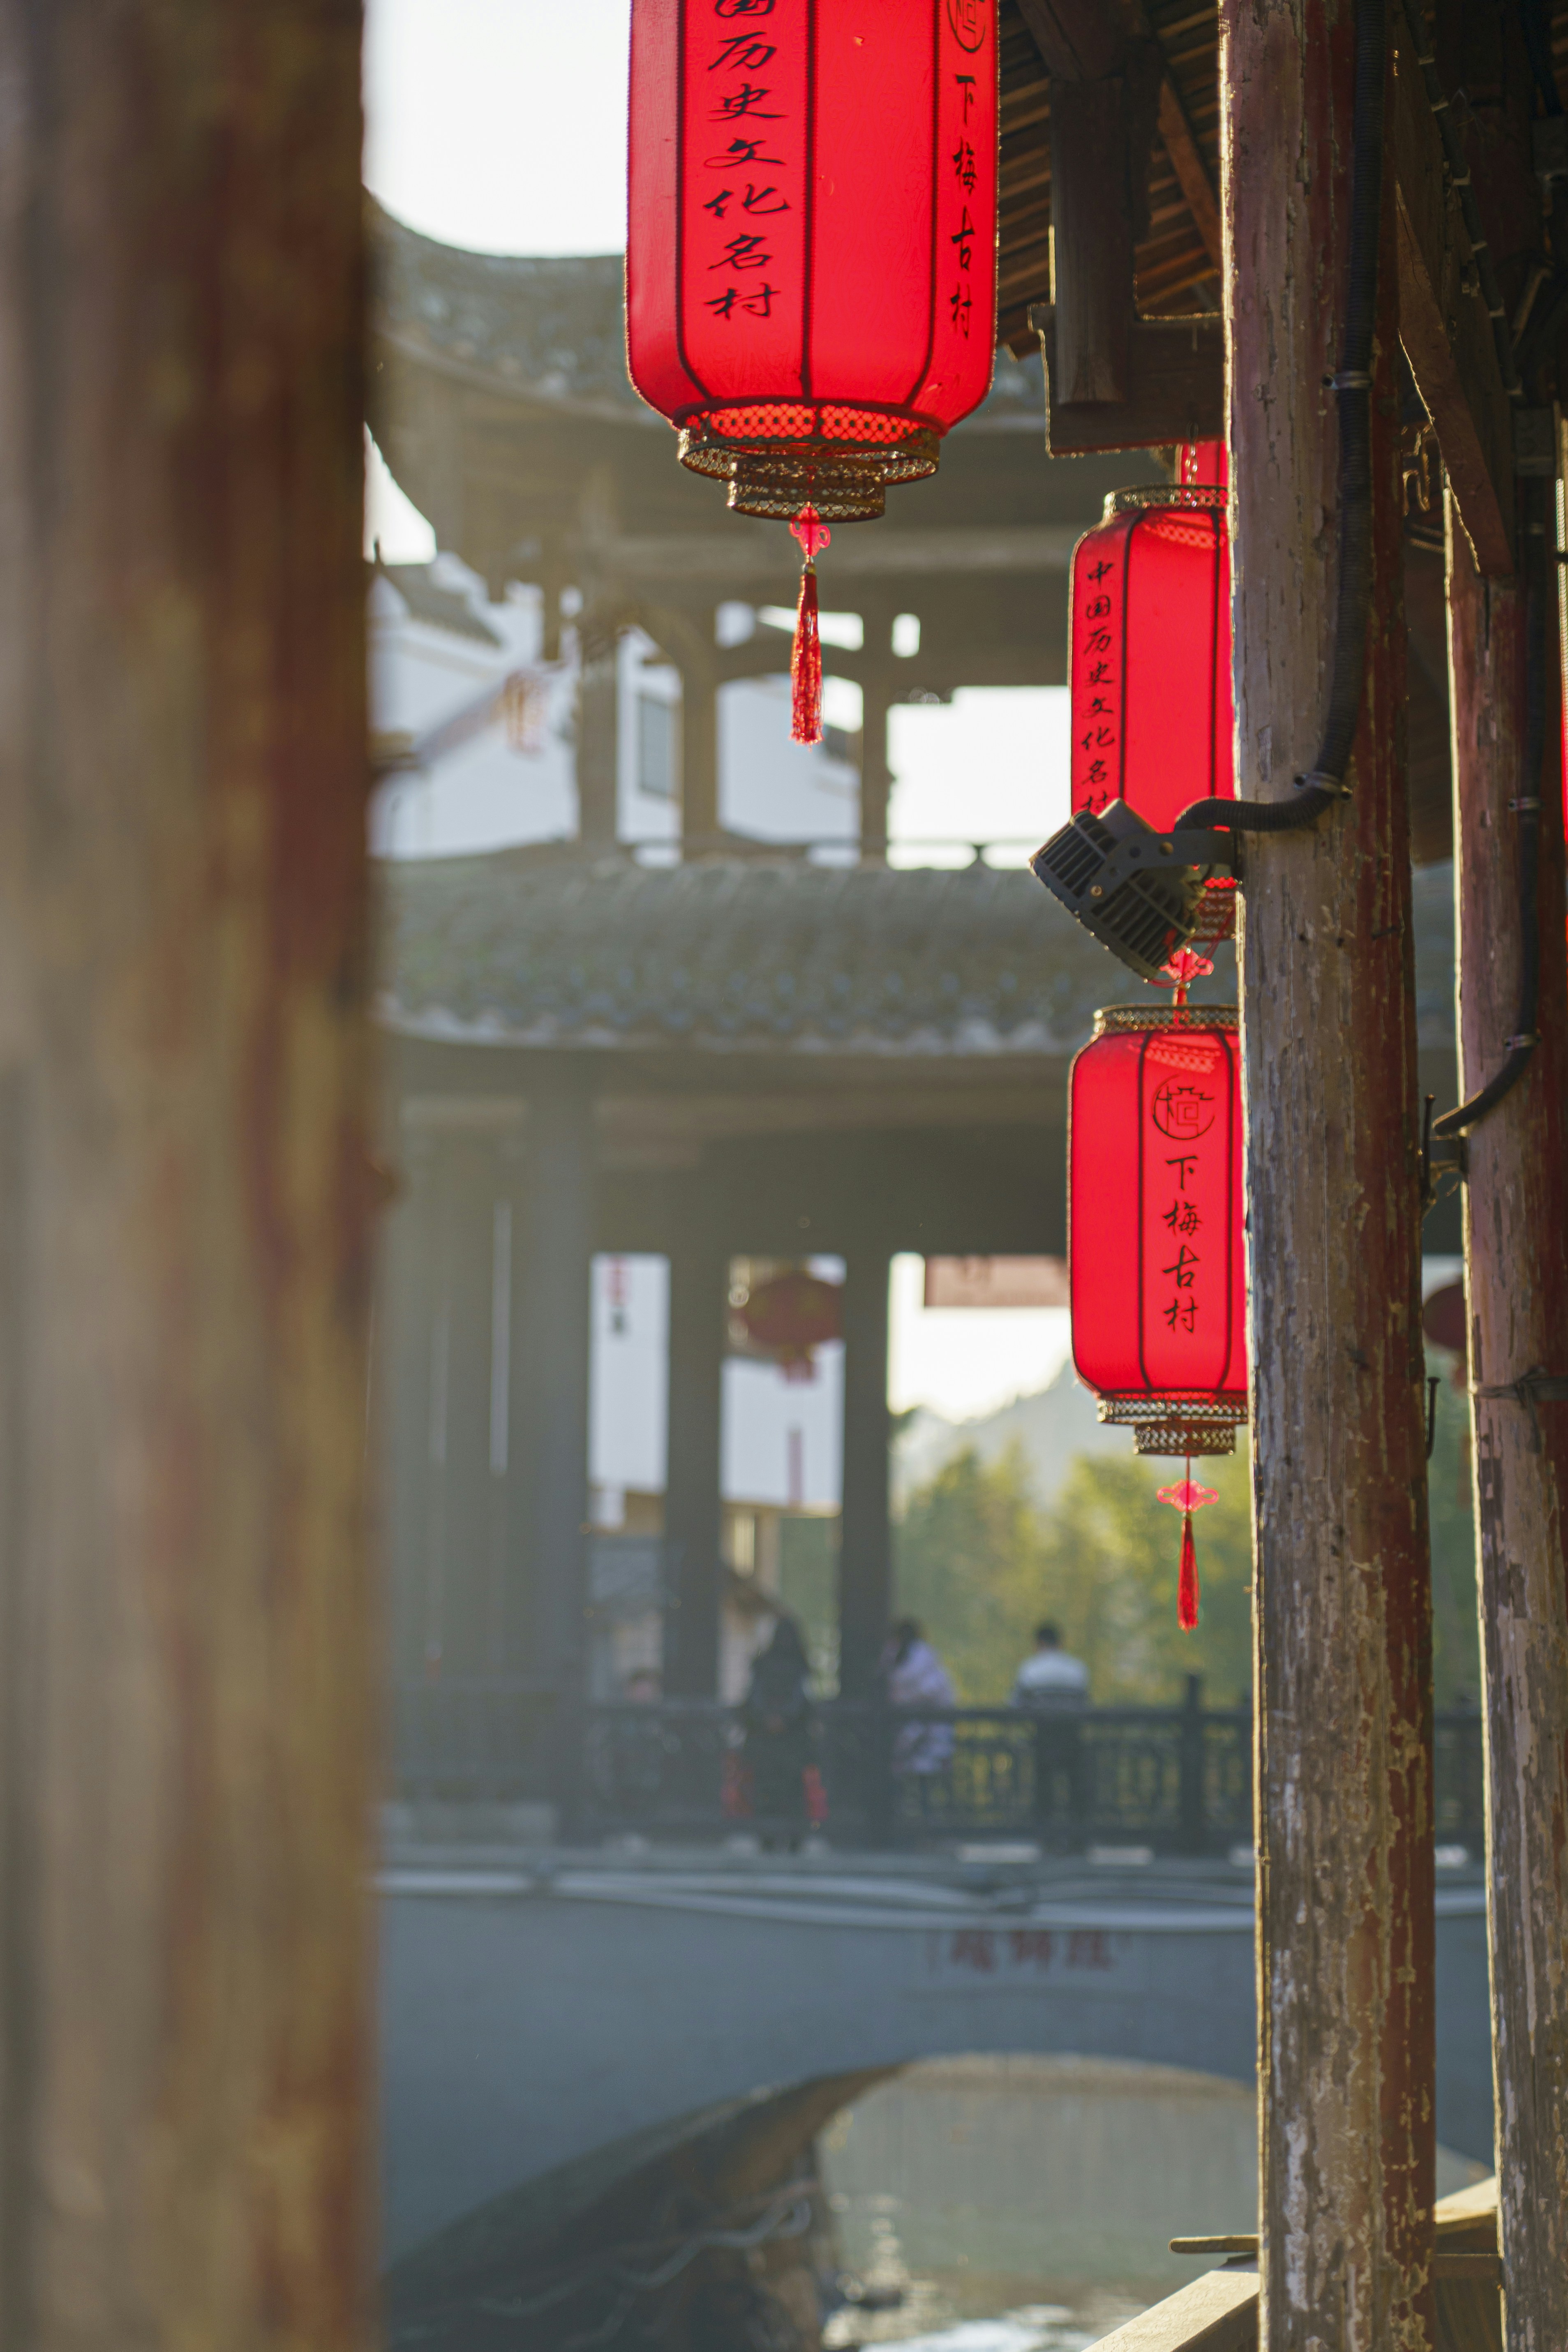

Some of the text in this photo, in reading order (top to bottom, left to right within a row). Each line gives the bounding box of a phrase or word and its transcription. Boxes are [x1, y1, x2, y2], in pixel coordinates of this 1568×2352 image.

[950, 74, 977, 339] 下梅古村
[1163, 1155, 1202, 1333] 下梅古村
